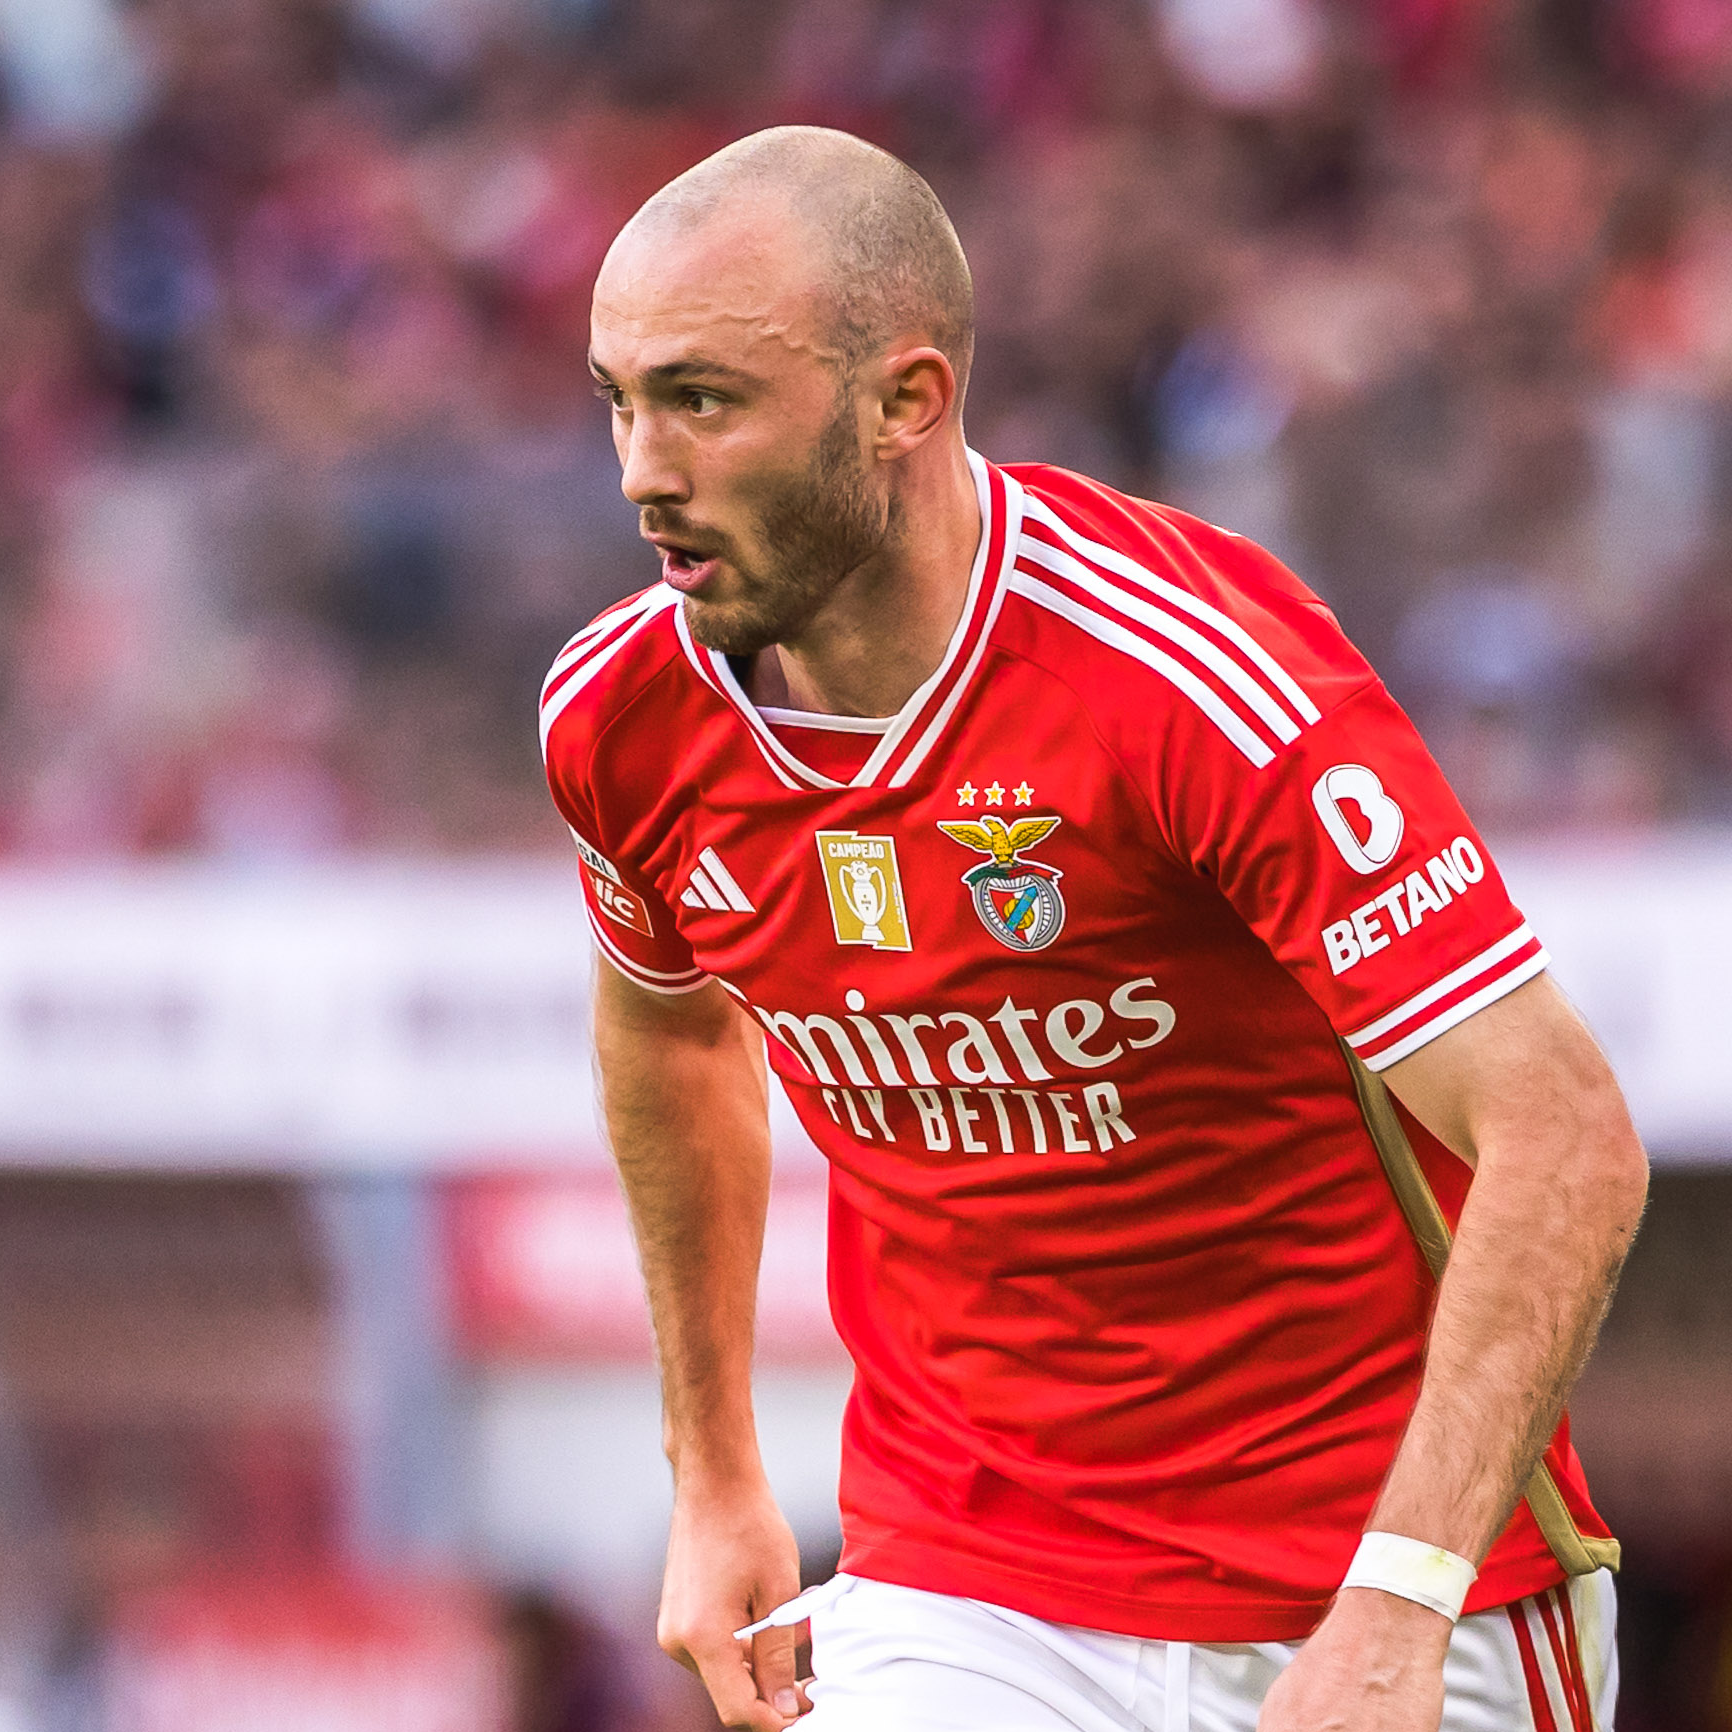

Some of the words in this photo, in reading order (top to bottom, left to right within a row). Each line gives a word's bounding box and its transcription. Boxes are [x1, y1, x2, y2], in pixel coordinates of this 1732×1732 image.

[828, 841, 886, 860] CAMPEÃO
[1320, 835, 1485, 977] BETANO
[716, 975, 1176, 1087] mirates
[907, 1081, 1138, 1155] BETTER
